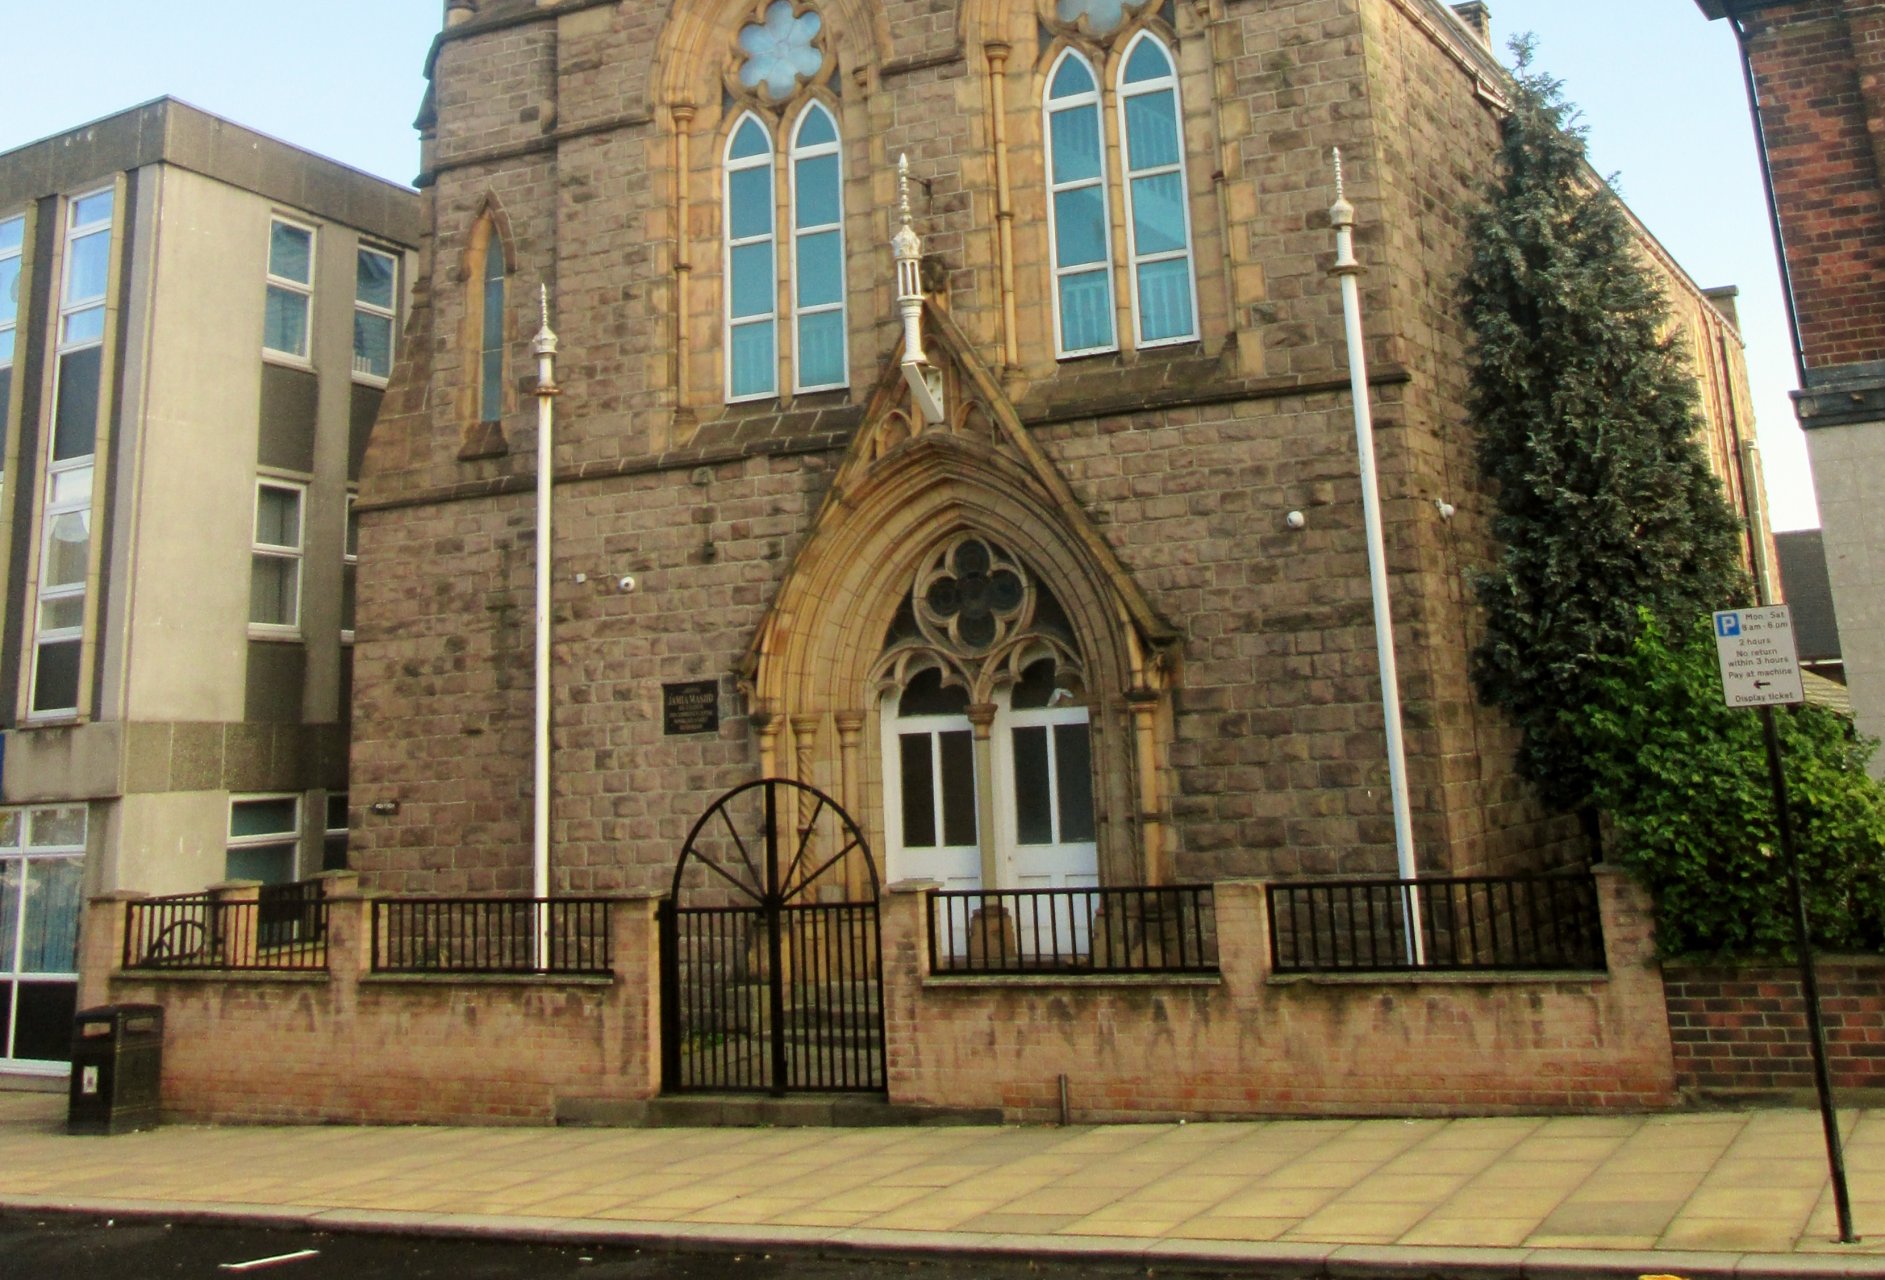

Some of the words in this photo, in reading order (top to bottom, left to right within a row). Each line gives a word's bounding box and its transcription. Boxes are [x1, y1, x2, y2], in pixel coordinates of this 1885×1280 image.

[1723, 616, 1736, 634] P
[1747, 637, 1771, 645] hours
[1751, 648, 1777, 656] return
[1728, 659, 1753, 667] within
[1765, 656, 1789, 664] hours
[1729, 671, 1743, 679] Pay
[1757, 667, 1792, 676] machine
[1736, 694, 1766, 702] Display
[1769, 692, 1793, 700] ticket
